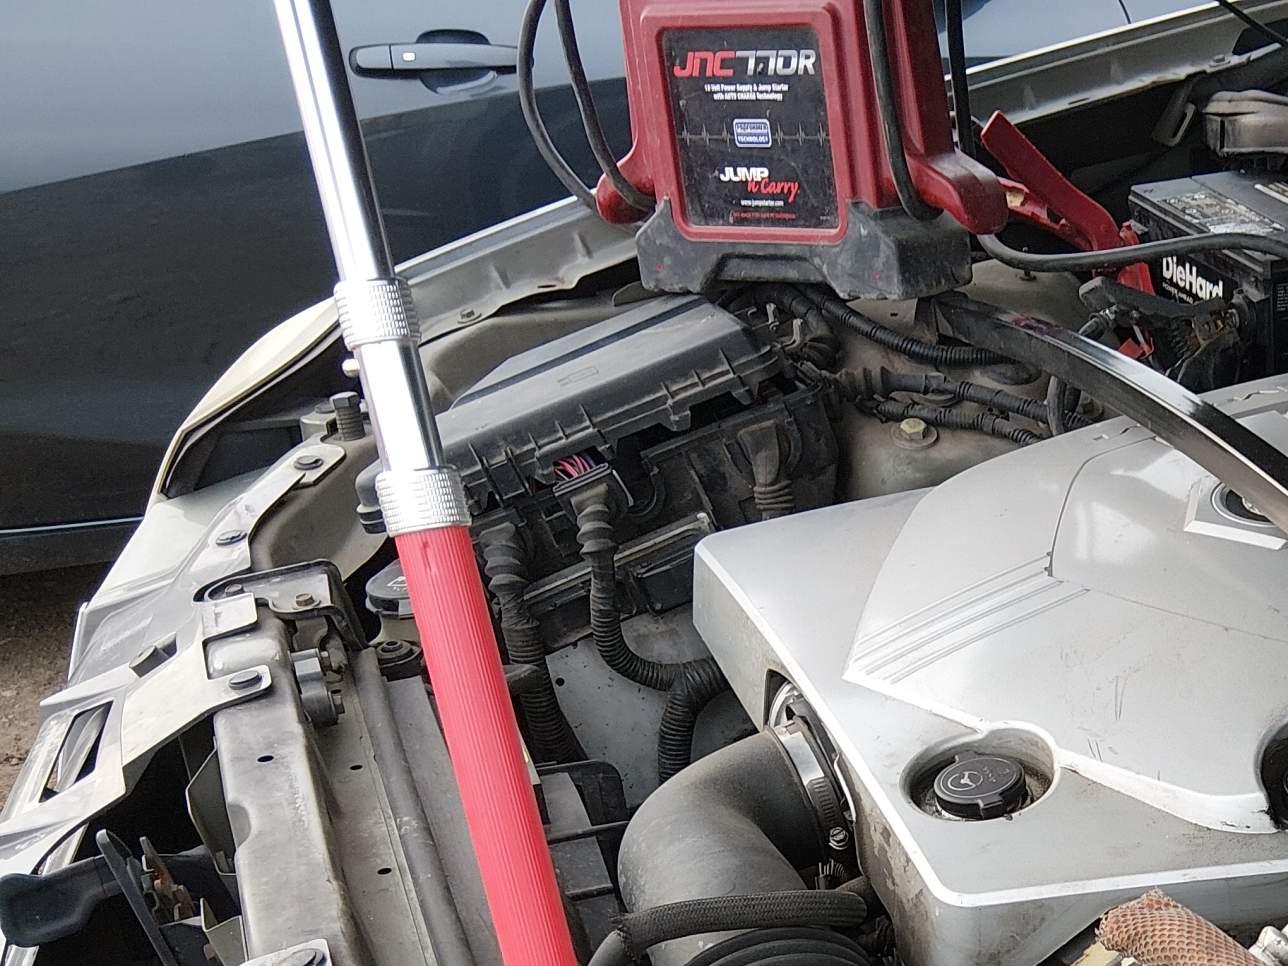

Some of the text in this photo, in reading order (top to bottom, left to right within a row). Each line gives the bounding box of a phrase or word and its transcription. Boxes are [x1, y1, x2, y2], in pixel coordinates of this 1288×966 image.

[720, 166, 769, 182] JUMP
[760, 178, 799, 203] Carry
[1162, 255, 1223, 301] DieHard
